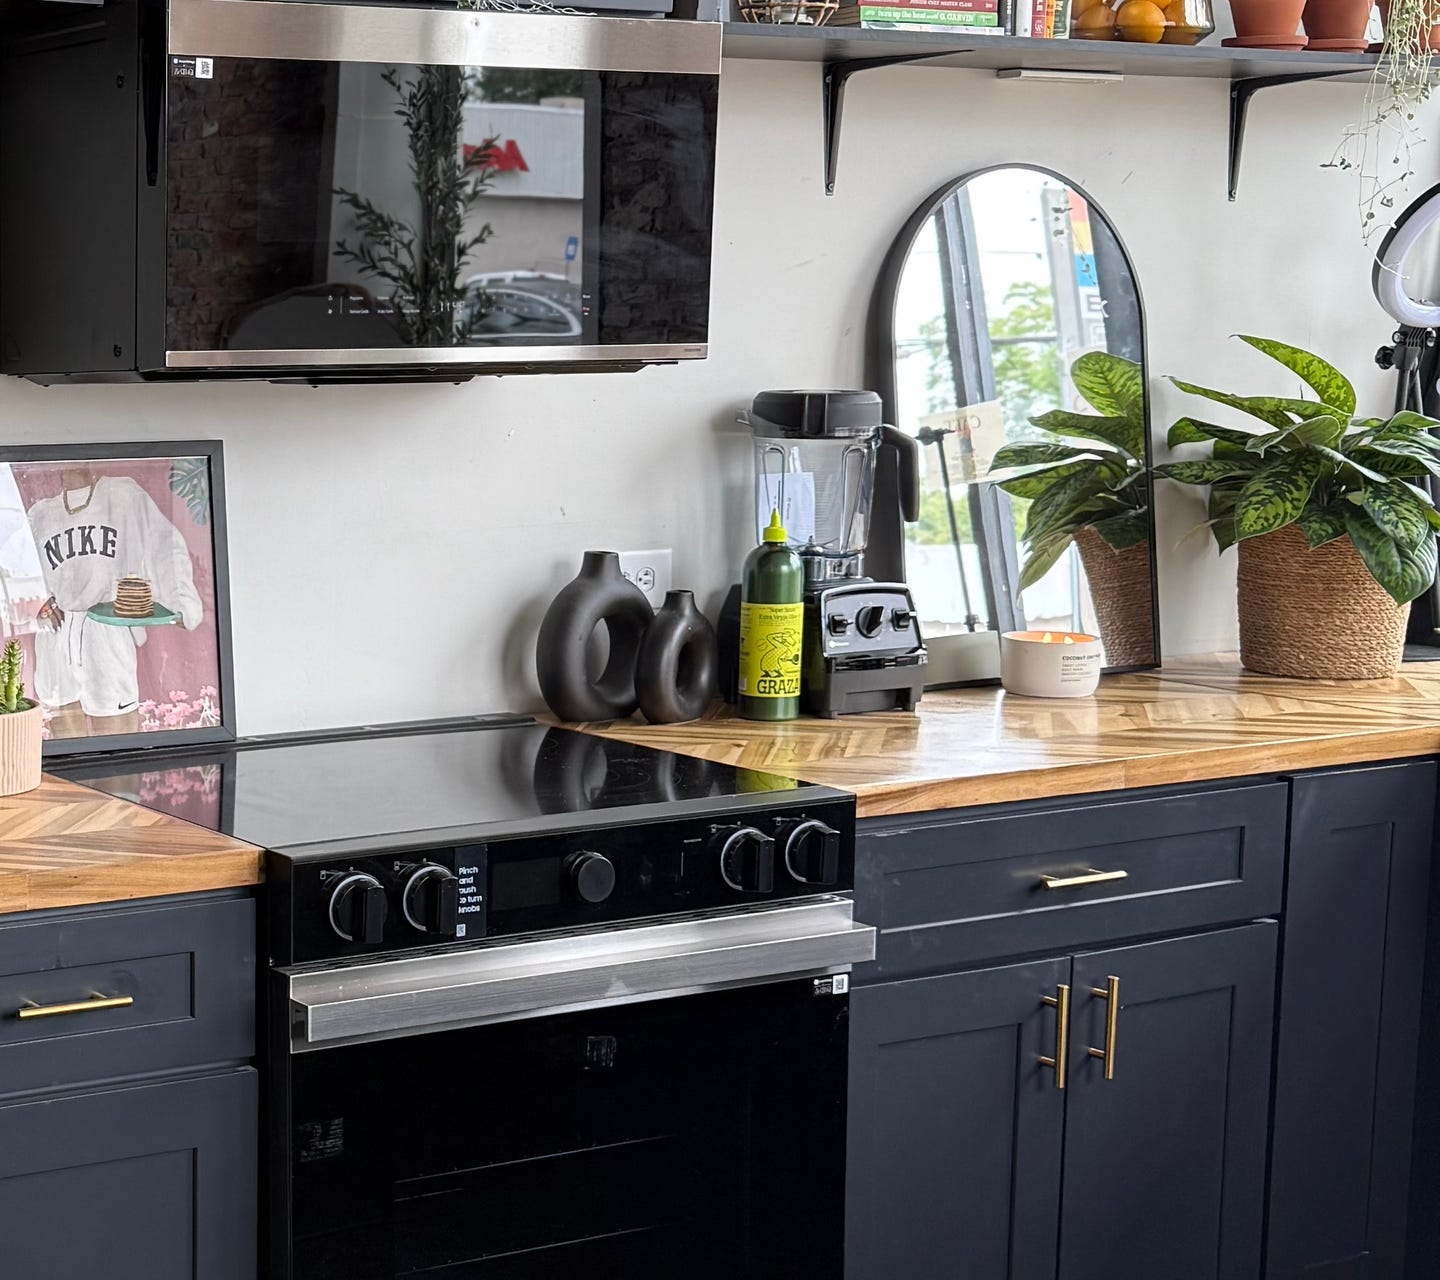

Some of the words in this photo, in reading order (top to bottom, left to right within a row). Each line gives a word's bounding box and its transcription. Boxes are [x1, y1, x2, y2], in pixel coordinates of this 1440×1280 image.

[44, 525, 117, 570] NIKE
[459, 866, 478, 875] Pinch
[458, 876, 473, 885] and
[467, 895, 482, 903] turn
[458, 905, 480, 914] knobs
